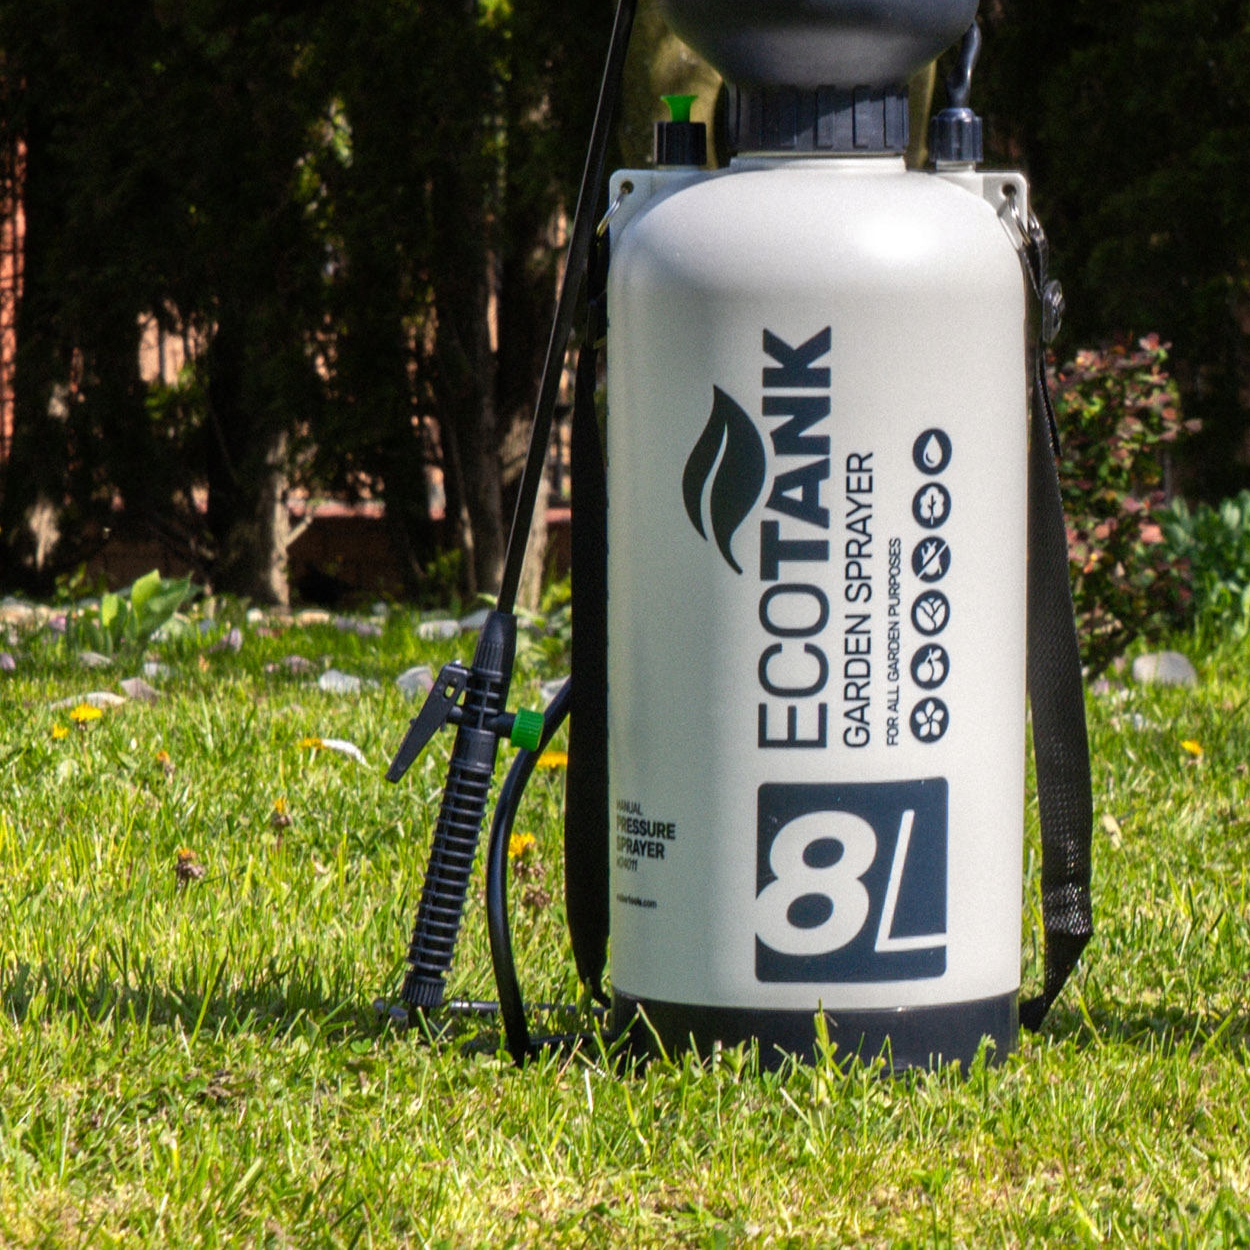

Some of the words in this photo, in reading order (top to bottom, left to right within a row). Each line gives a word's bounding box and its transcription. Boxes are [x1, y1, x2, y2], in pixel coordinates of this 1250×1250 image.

[757, 325, 833, 749] ECOTANK
[843, 452, 874, 604] SPRAYER
[887, 537, 901, 617] PURPOSES
[842, 613, 872, 749] GARDEN
[886, 621, 900, 682] GARDEN
[886, 686, 899, 713] ALL
[886, 716, 899, 747] FOR
[616, 814, 676, 841] PRESSURE
[616, 835, 665, 860] SPRAYER
